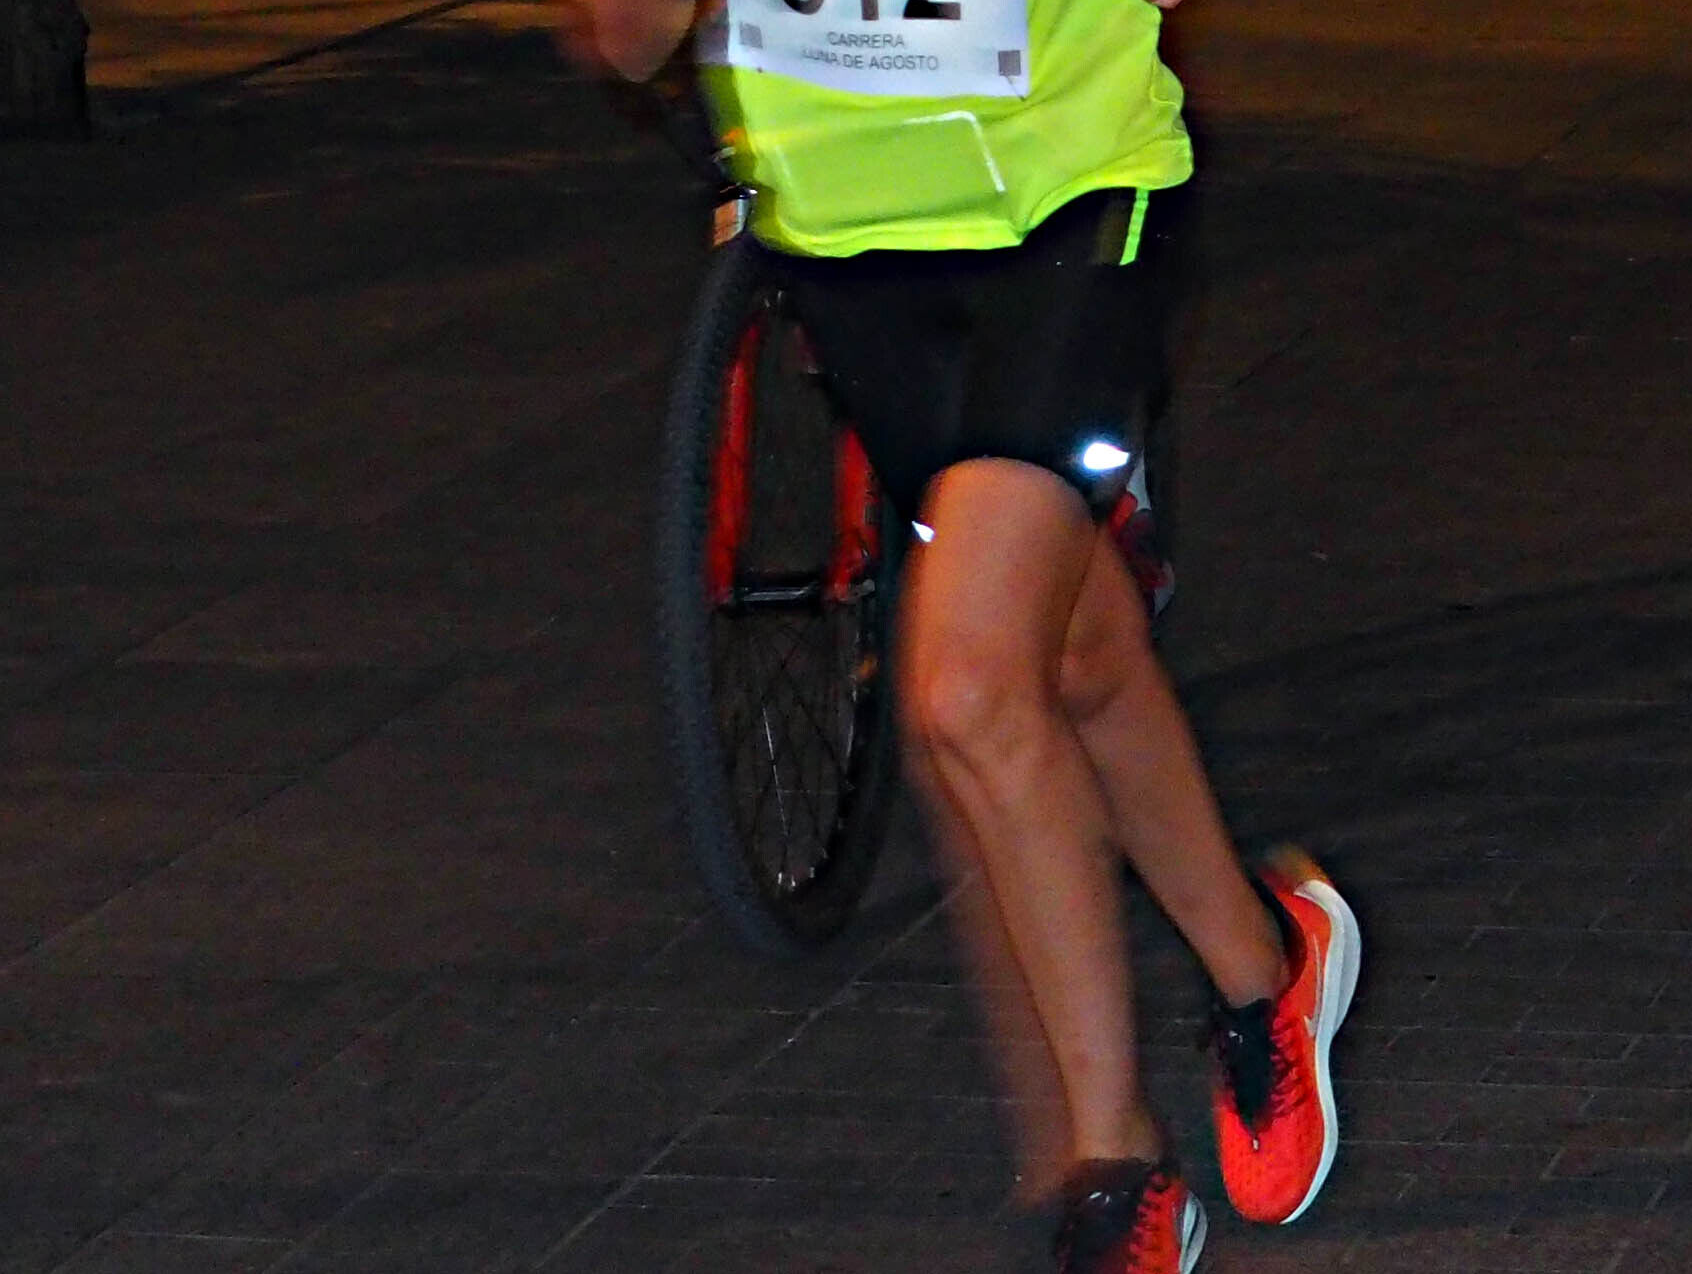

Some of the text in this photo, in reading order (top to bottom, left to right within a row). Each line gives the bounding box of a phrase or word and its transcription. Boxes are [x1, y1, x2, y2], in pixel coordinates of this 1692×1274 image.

[826, 31, 905, 49] CARRERA
[802, 49, 940, 71] LUNA DE AGOSTO
